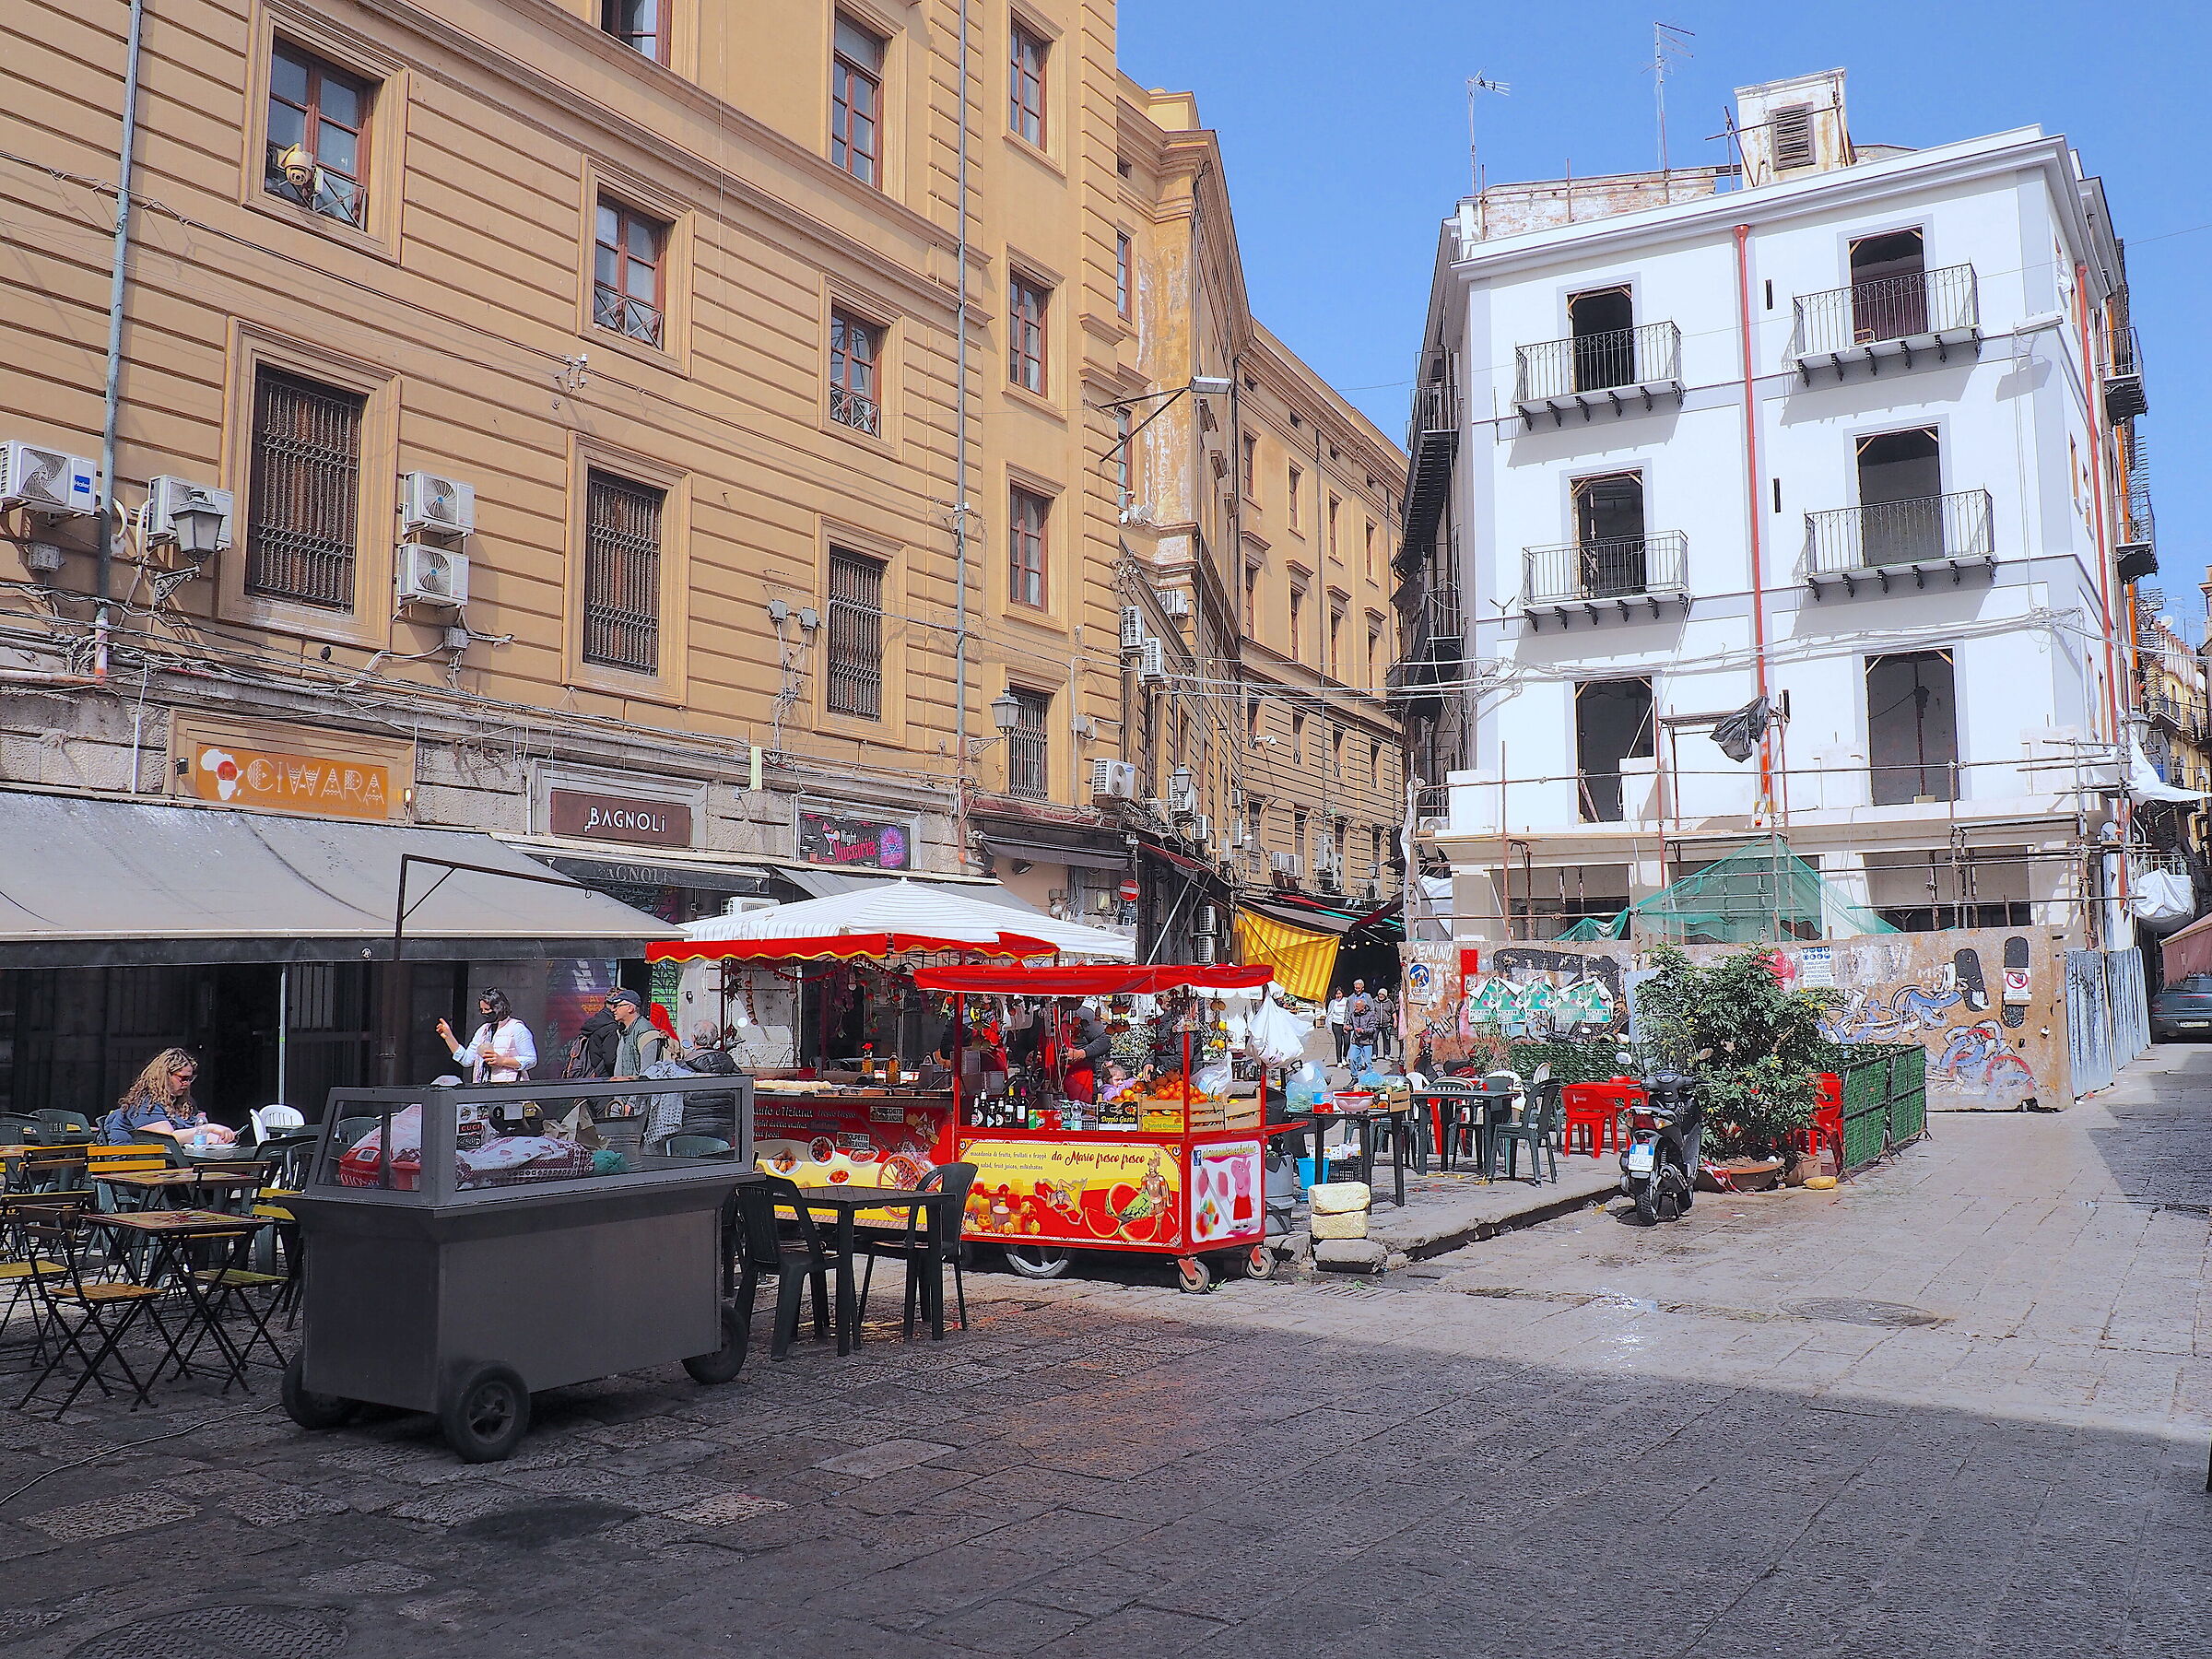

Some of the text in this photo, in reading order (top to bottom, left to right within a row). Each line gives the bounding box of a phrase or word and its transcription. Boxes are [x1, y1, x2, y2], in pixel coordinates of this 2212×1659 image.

[74, 480, 90, 489] Haier
[247, 759, 384, 806] CIWARA
[841, 828, 858, 845] Night
[833, 838, 877, 862] Vucciria
[1119, 1115, 1135, 1124] Gusto
[1051, 1150, 1146, 1171] da Mario fresco fresco
